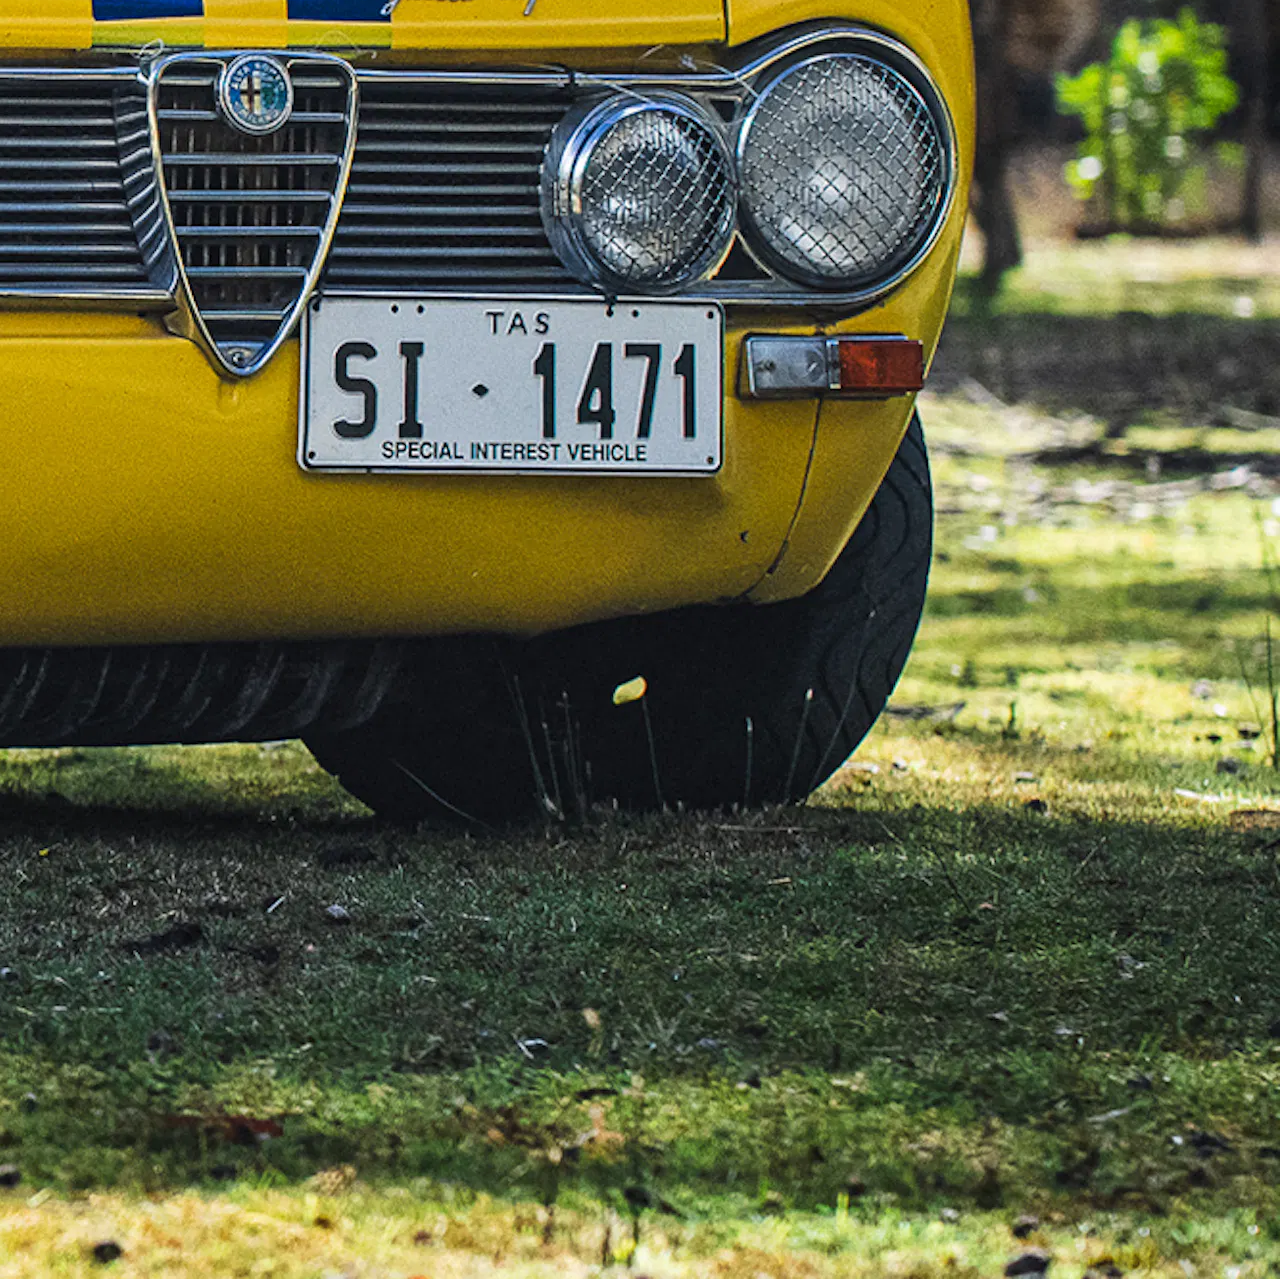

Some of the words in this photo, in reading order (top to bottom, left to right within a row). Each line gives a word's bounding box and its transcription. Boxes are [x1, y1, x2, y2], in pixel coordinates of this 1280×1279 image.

[485, 311, 551, 336] TAS
[332, 340, 425, 440] SI
[532, 341, 698, 441] 1471
[381, 440, 465, 460] SPECIAL
[470, 441, 562, 462] INTEREST
[567, 442, 648, 463] VEHICLE
